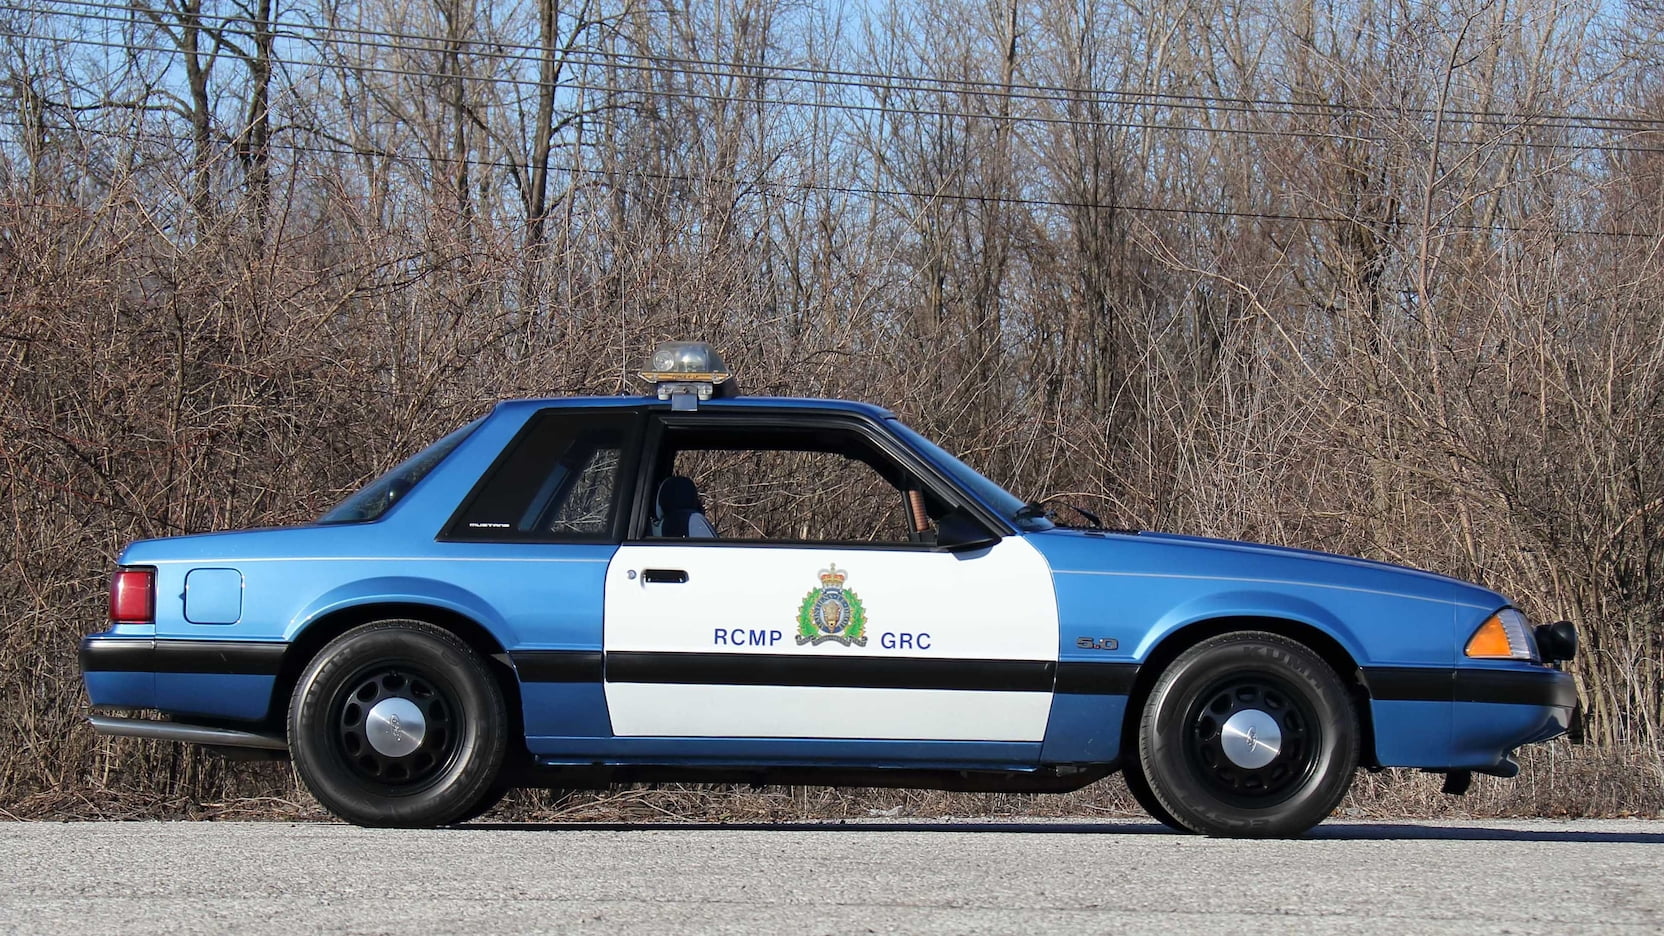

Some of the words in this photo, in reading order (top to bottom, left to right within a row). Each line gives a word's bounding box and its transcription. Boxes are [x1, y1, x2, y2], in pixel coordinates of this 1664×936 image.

[714, 628, 782, 646] RCMP
[881, 632, 931, 650] GRC
[1077, 637, 1119, 650] 5.0
